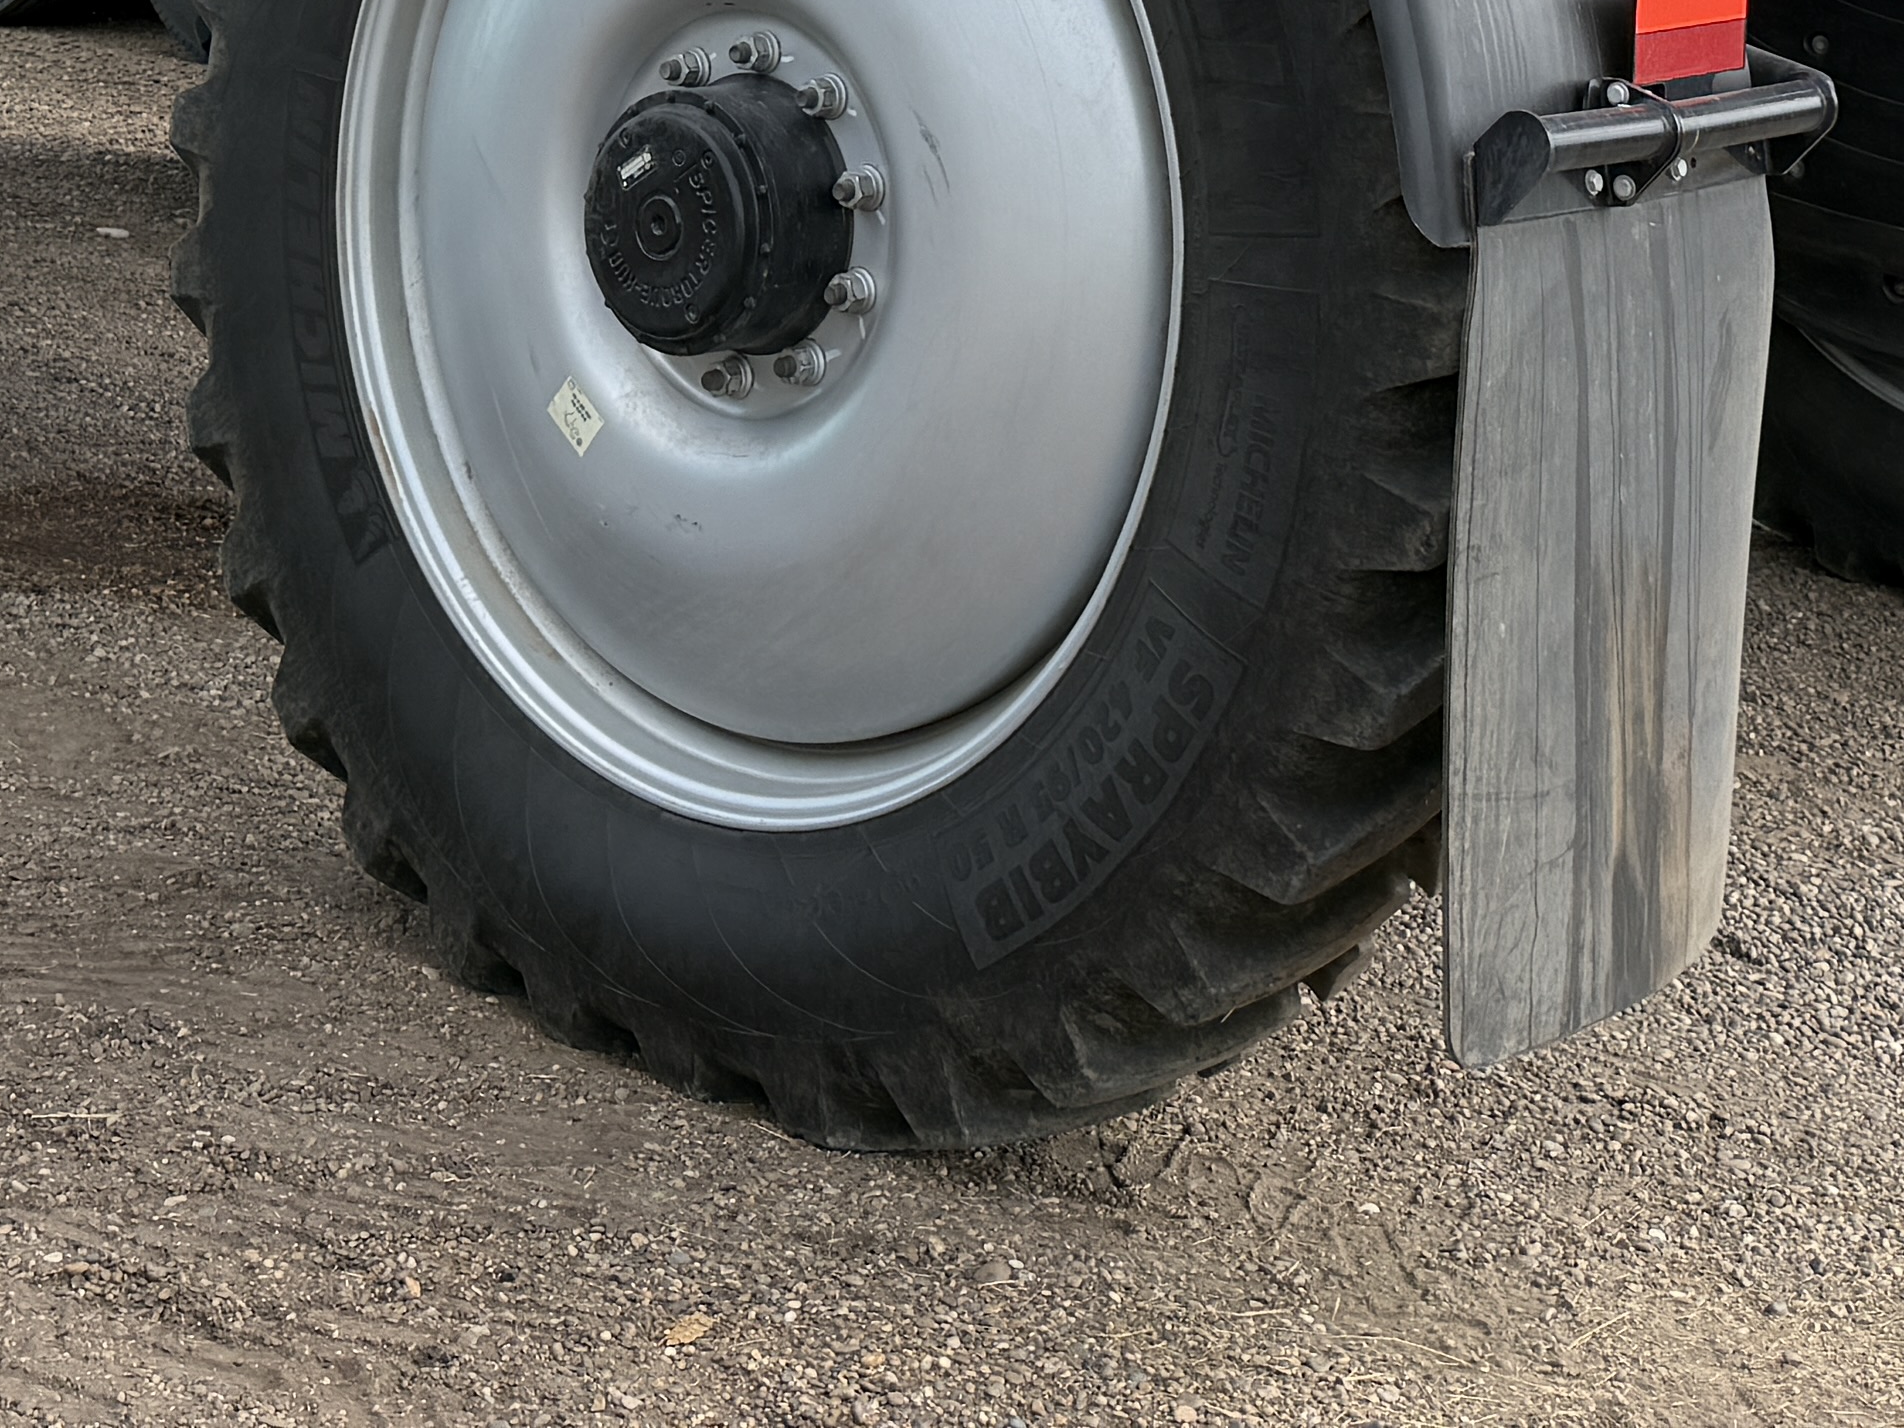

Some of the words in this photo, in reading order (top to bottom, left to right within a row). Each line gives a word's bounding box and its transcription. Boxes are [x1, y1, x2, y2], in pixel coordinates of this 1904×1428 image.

[1221, 393, 1280, 575] MICHELIN
[1136, 616, 1176, 683] VF
[975, 658, 1214, 941] SPRAYBIB
[998, 803, 1030, 848] R
[949, 827, 995, 882] 50
